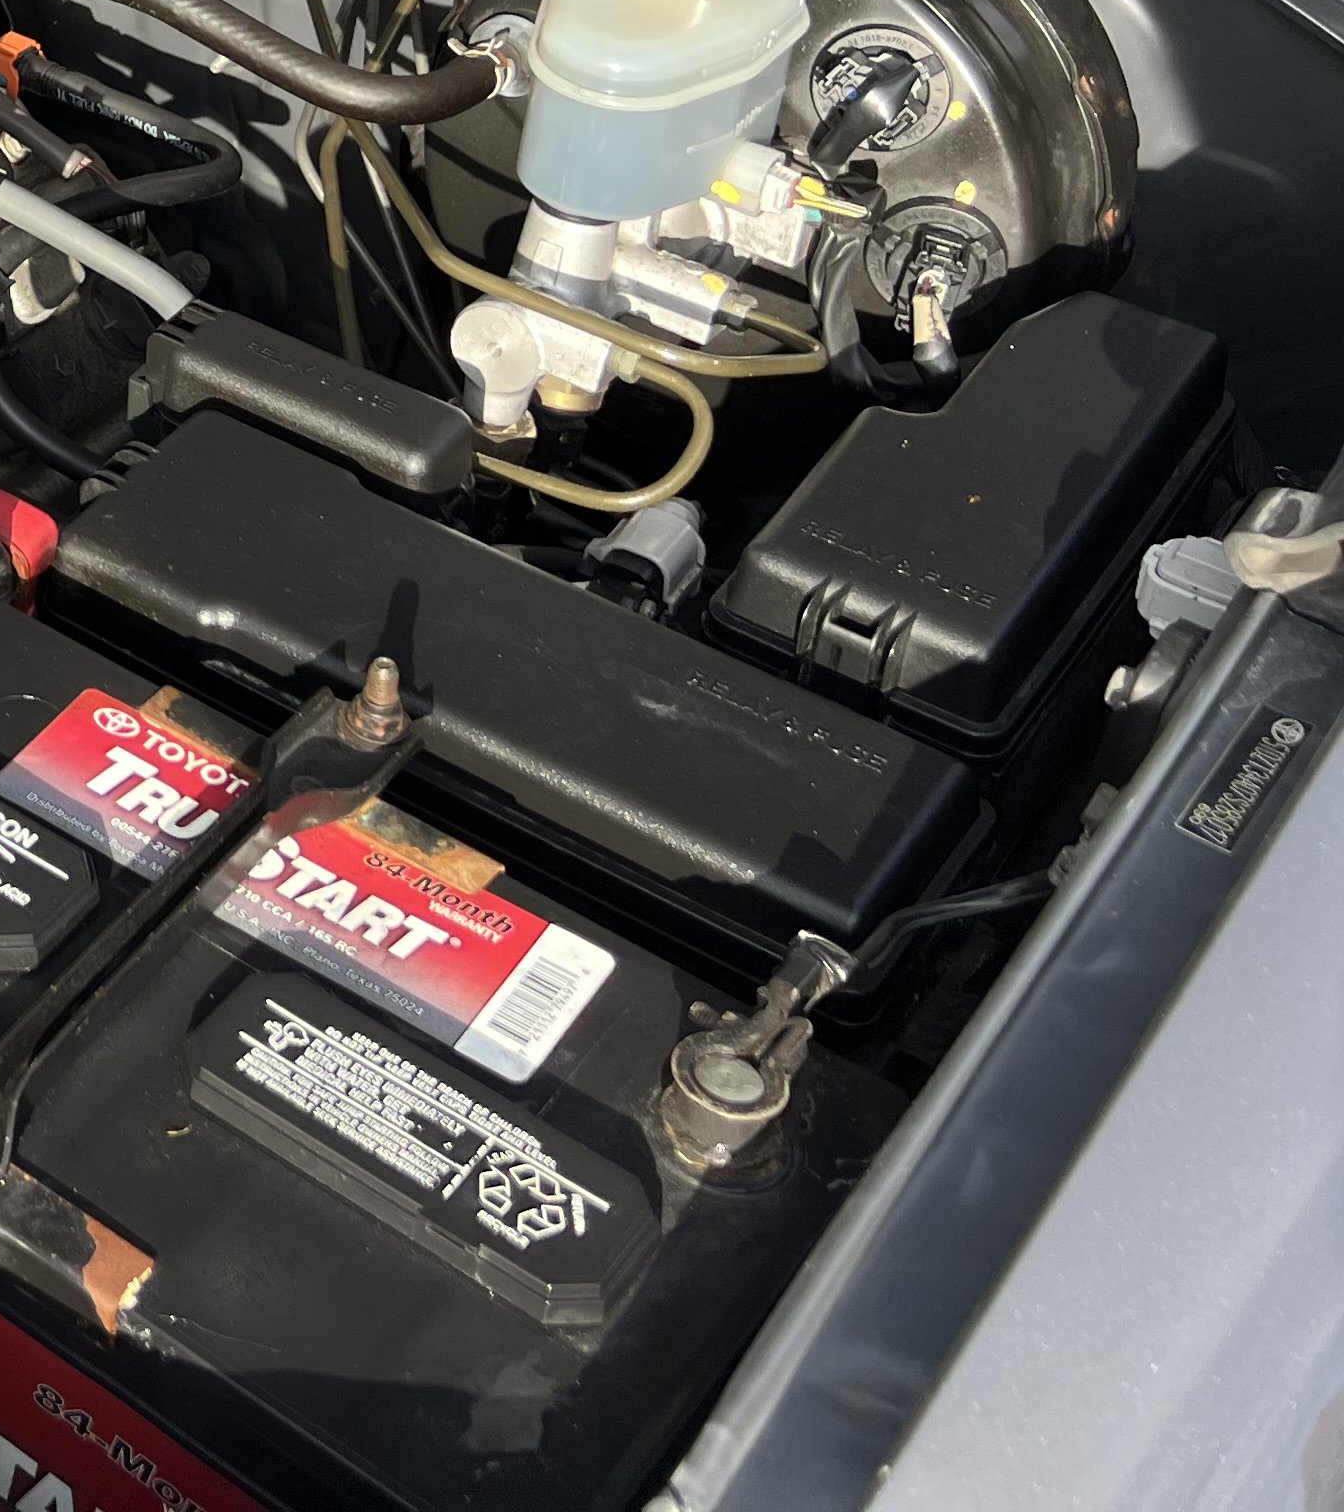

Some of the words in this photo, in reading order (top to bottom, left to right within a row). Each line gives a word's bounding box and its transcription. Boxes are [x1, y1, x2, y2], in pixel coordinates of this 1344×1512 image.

[800, 521, 896, 565] RELAY
[918, 571, 998, 610] FUSE
[686, 671, 785, 723] RELAY
[807, 727, 888, 774] FUSE
[143, 729, 250, 797] TOYOT
[0, 883, 32, 907] ACID
[25, 791, 93, 833] Distributed
[345, 966, 381, 994] Texas
[381, 987, 425, 1017] 75024
[263, 898, 293, 922] CCA
[308, 925, 333, 948] 165
[334, 938, 357, 957] RC
[364, 852, 514, 935] 84-Month
[428, 899, 504, 944] WARRANTY
[295, 1054, 349, 1093] MEDICAL
[348, 1088, 384, 1113] HELP
[304, 1047, 338, 1073] WITH
[383, 1095, 412, 1116] GET
[311, 1038, 353, 1070] FLUSH
[350, 1062, 385, 1088] EYES
[382, 1081, 467, 1138] IMMEDIATELY
[485, 1149, 517, 1166] LEAD
